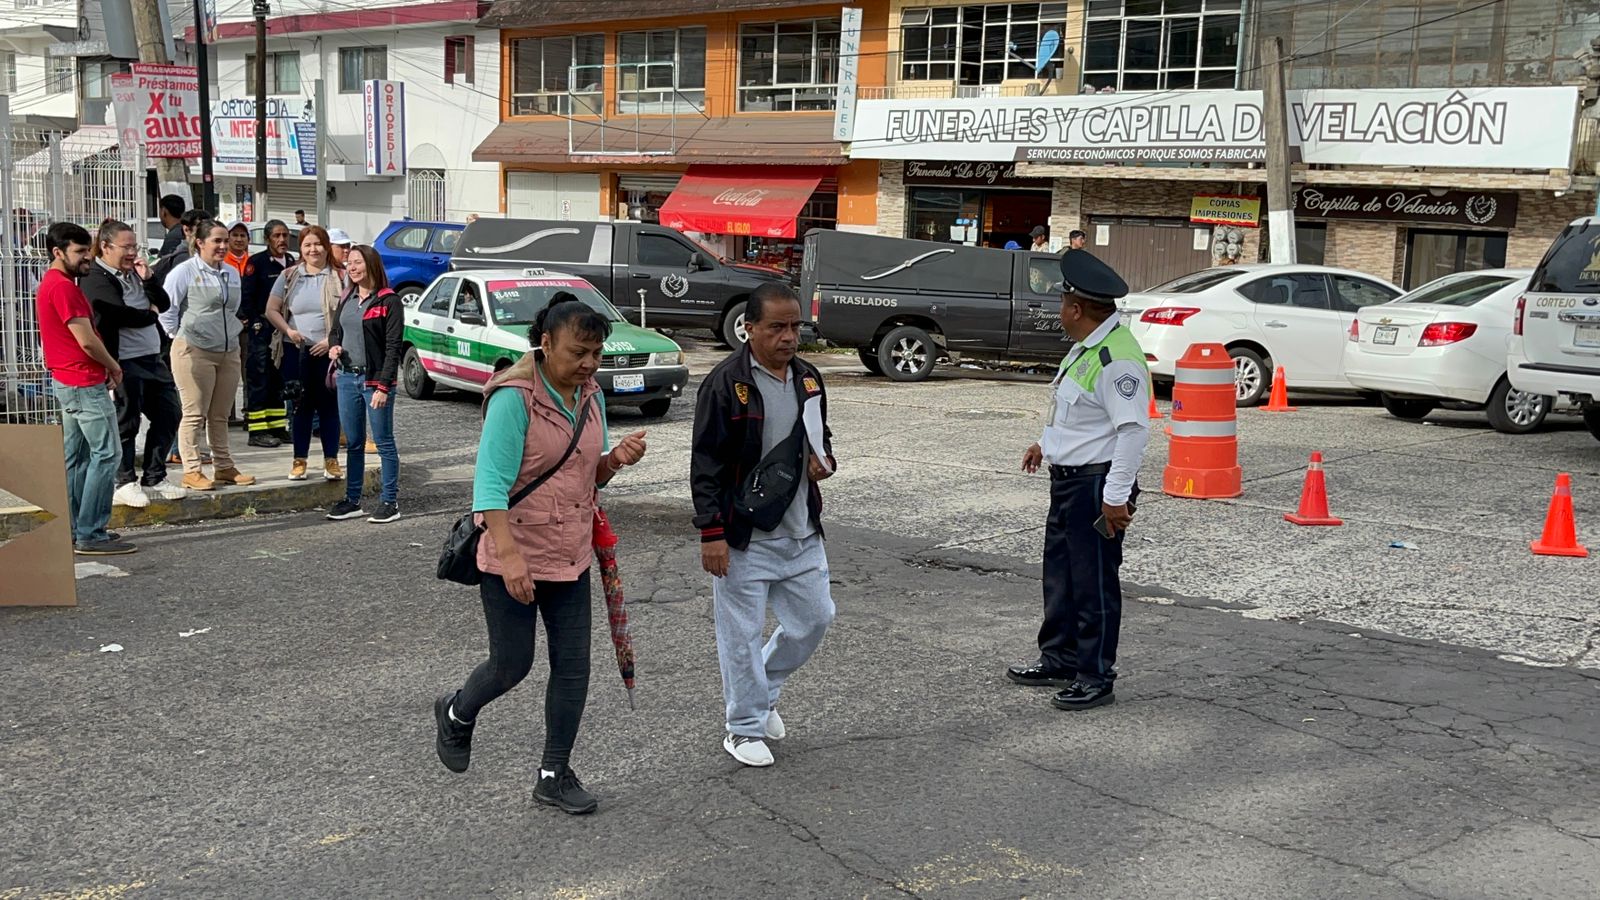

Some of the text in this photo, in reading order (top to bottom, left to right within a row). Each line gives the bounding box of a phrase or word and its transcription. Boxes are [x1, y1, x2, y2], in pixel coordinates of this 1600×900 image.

[838, 13, 856, 137] FUNERALES
[139, 77, 199, 92] Préstamos
[169, 94, 182, 106] tu
[221, 99, 289, 116] ORTODIA
[144, 111, 201, 138] auto
[886, 90, 1507, 145] FUNERALES Y CAPILLA D VELACIÓN
[230, 120, 281, 138] INTEAL
[366, 84, 374, 169] ORTOPEDIA
[384, 83, 396, 171] ORTOPEDIA
[1027, 147, 1267, 161] SERVICIOS ECONÓMICOS PORQUE SOMOS FABRICAN
[906, 161, 951, 178] Funerales
[1209, 199, 1240, 208] COPIAS
[1303, 188, 1459, 217] Capilla de Velación
[1195, 210, 1253, 220] IMPRESIONES
[832, 295, 898, 308] TRASLADOS
[1536, 297, 1577, 308] CORTEJO
[457, 340, 470, 357] TAXI
